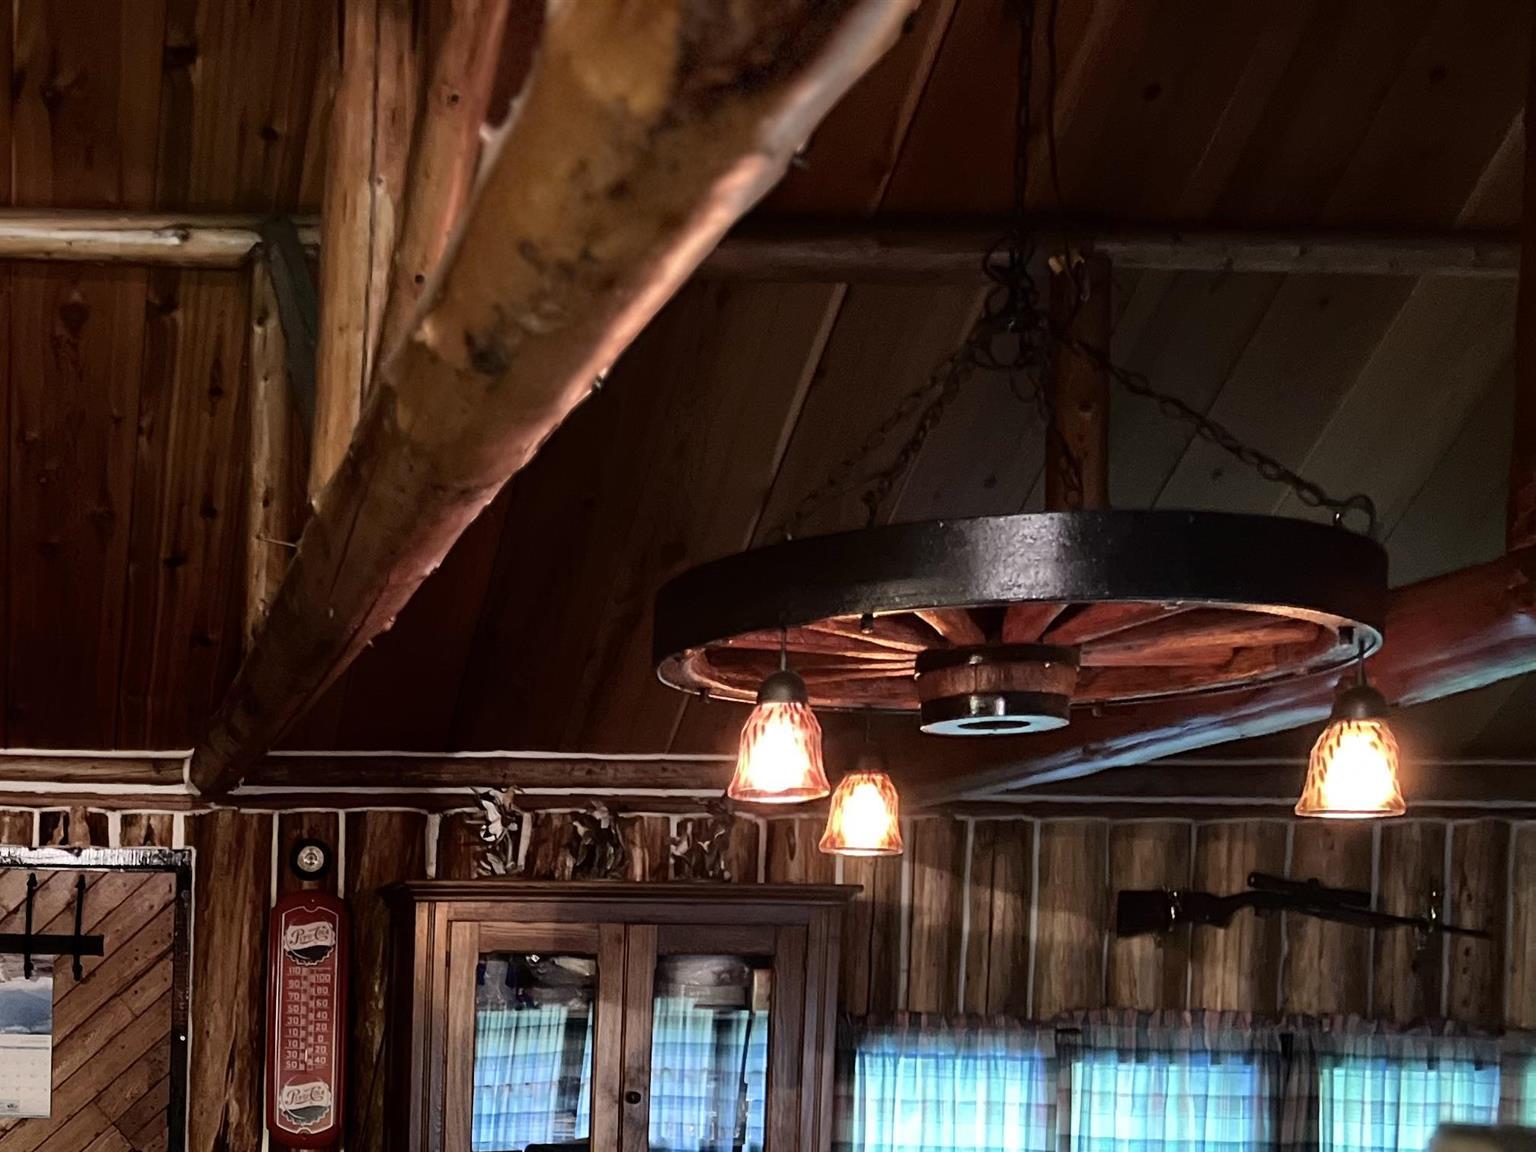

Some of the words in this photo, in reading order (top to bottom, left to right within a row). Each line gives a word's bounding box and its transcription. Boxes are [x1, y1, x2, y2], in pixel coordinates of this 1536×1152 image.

[316, 973, 331, 983] 100
[287, 992, 300, 1001] 70
[287, 1004, 300, 1013] 50
[315, 1010, 328, 1019] 40
[287, 1016, 299, 1025] 30
[315, 1022, 328, 1031] 20
[288, 1028, 299, 1037] 10
[317, 1034, 324, 1043] 0
[287, 1039, 298, 1048] 10
[314, 1045, 327, 1054] 20
[286, 1050, 298, 1059] 30
[285, 1060, 298, 1069] 50
[314, 1056, 327, 1065] 40
